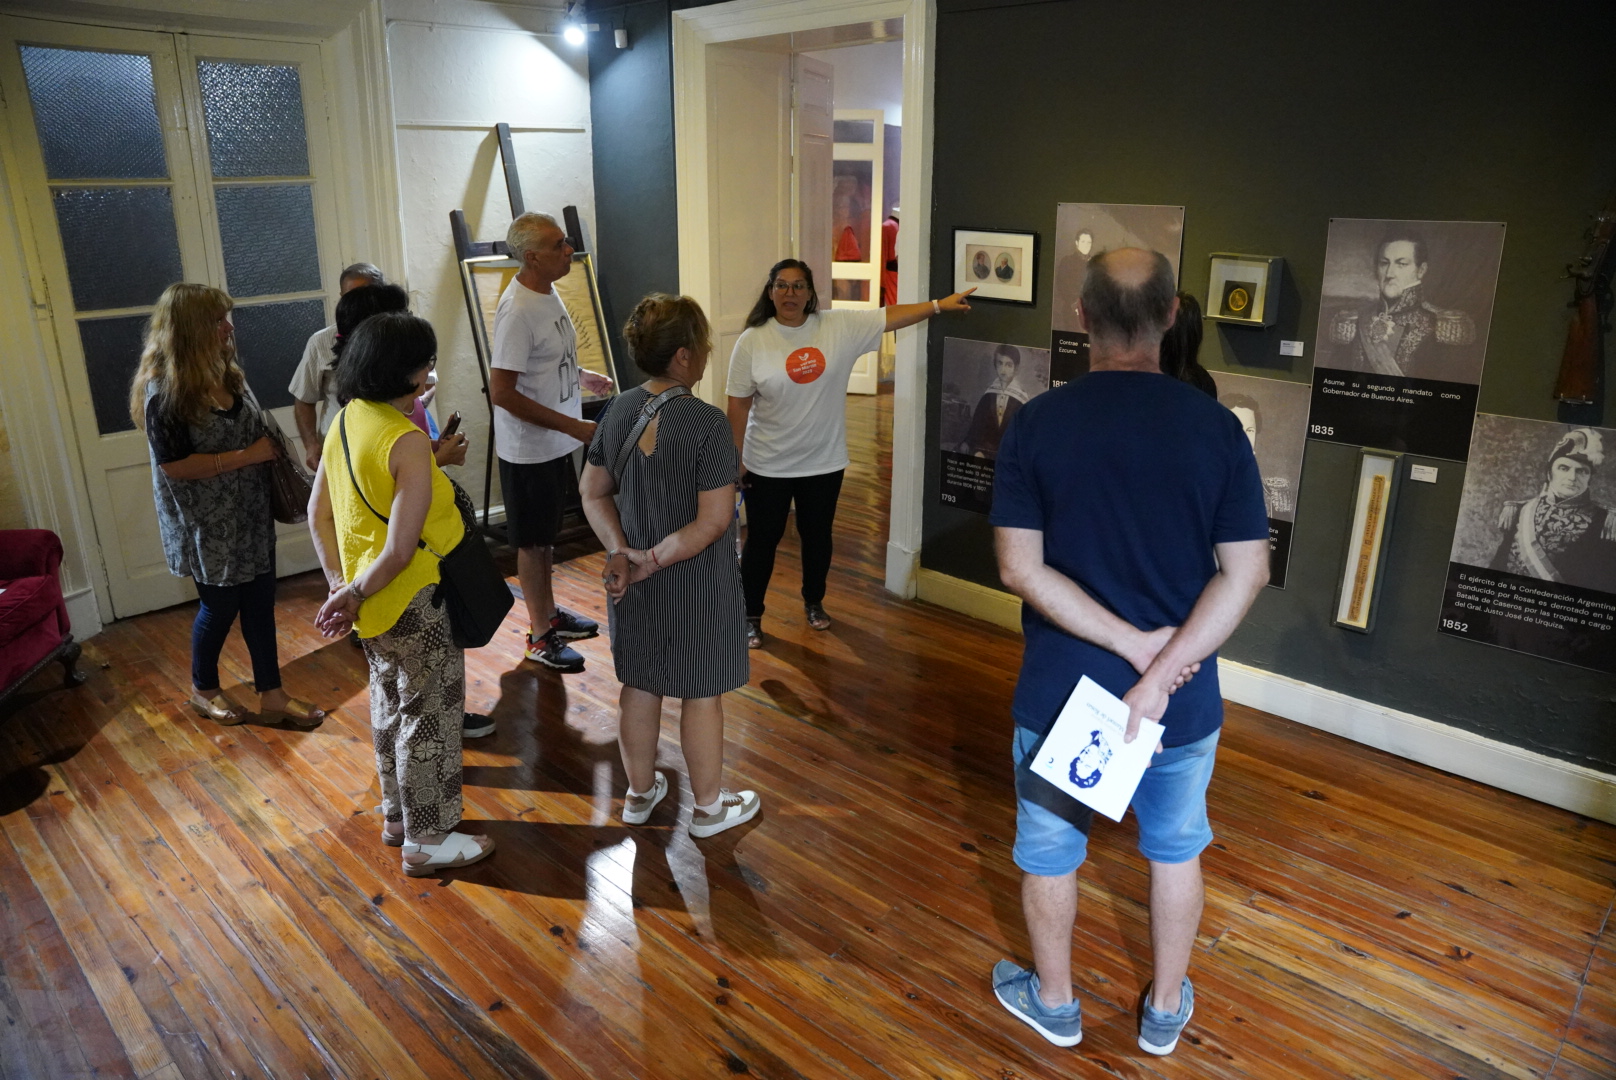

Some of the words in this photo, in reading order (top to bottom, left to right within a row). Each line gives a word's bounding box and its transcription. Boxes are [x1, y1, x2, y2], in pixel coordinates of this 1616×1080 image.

[1322, 388, 1360, 397] Gobernador
[1371, 392, 1395, 401] Buenos
[1397, 396, 1414, 404] Aires.
[1324, 378, 1345, 387] Asume
[1367, 384, 1395, 392] segundo
[1403, 387, 1433, 396] mandato
[1441, 392, 1461, 400] como
[1310, 424, 1334, 436] 1835
[941, 493, 956, 503] 1793
[1458, 583, 1495, 595] conducido
[1498, 591, 1510, 600] por
[1513, 594, 1535, 604] Rosas
[1551, 601, 1589, 616] derrotado
[1606, 612, 1614, 621] la
[1468, 575, 1495, 586] ejército
[1519, 586, 1575, 602] Confederación
[1577, 597, 1616, 611] Argentina
[1456, 592, 1479, 602] Batalla
[1481, 596, 1490, 604] de
[1492, 599, 1522, 611] Caseros
[1524, 606, 1537, 614] por
[1540, 608, 1550, 617] las
[1553, 612, 1578, 624] tropas
[1588, 621, 1611, 631] cargo
[1466, 602, 1482, 611] Gral.
[1484, 606, 1503, 616] Justo
[1505, 611, 1522, 620] José
[1524, 615, 1533, 623] de
[1535, 618, 1564, 630] Urquiza.
[1442, 618, 1468, 632] 1852
